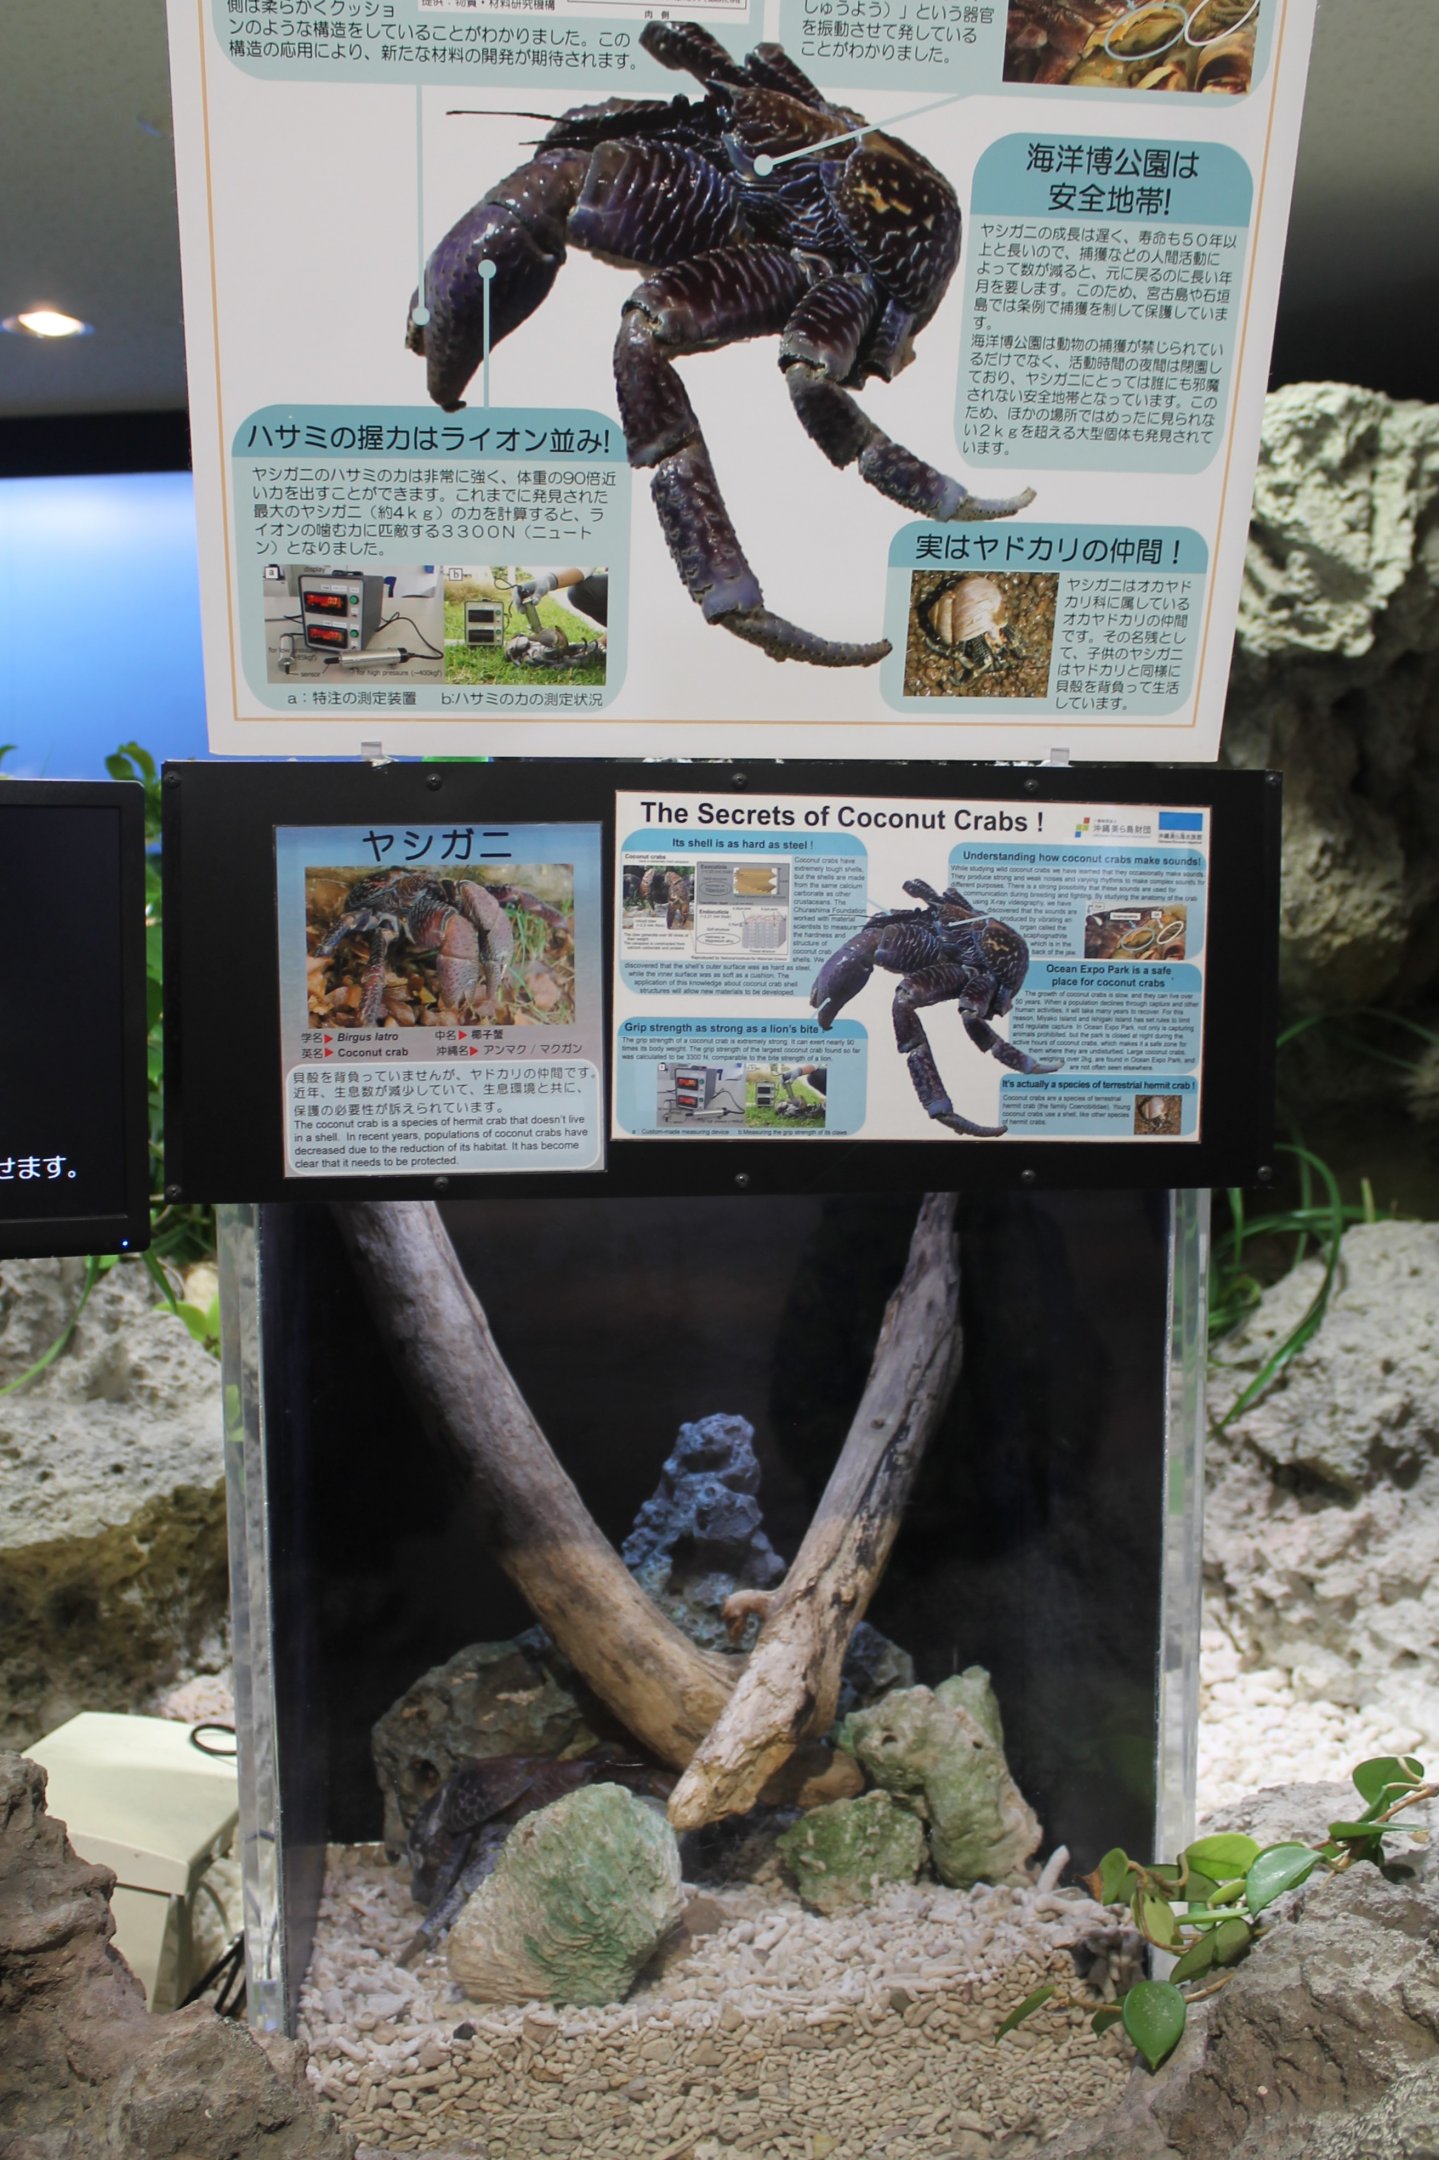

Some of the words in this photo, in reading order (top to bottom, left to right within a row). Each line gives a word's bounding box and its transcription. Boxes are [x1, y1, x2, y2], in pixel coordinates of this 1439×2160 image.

[802, 19, 977, 44] を振動させて発している
[801, 41, 950, 64] ことがわかりました。
[1026, 143, 1200, 179] 海洋博公園は
[973, 317, 992, 331] す。
[961, 442, 1011, 457] います。
[1066, 577, 1192, 593] ヤシガニはオカヤド
[1064, 595, 1191, 611] カリ科に属している
[1063, 612, 1188, 629] オカヤドカリの仲間
[1062, 629, 1186, 645] です。その名残とし
[1060, 646, 1184, 661] て、子供のヤシガニ
[1058, 663, 1181, 678] はヤドカリと同様に
[1056, 680, 1180, 695] 貝殻を背負って生活
[1055, 697, 1128, 711] しています。
[641, 802, 688, 823] The
[698, 803, 795, 826] Secrets
[804, 805, 830, 826] of
[837, 806, 946, 829] Coconut
[954, 809, 1028, 832] Crabs
[362, 827, 513, 862] ヤシガニ
[672, 838, 685, 848] Its
[688, 838, 713, 848] shell
[716, 838, 724, 848] is
[727, 840, 739, 848] as
[742, 839, 765, 849] hard
[768, 841, 780, 849] as
[783, 840, 808, 850] steel
[963, 851, 1036, 863] Understanding
[1039, 853, 1060, 862] how
[1062, 855, 1102, 864] coconut
[1104, 855, 1132, 864] crabs
[1134, 856, 1161, 865] make
[1162, 857, 1202, 866] sounds!
[1046, 963, 1077, 973] Ocean
[1080, 964, 1105, 975] Expo
[1108, 965, 1129, 974] Park
[1132, 966, 1140, 974] is
[1151, 966, 1172, 975] safe
[1052, 977, 1078, 987] place
[1081, 977, 1094, 986] for
[1097, 979, 1136, 987] coconut
[1139, 979, 1165, 987] crabs
[434, 1030, 456, 1041] 中名
[624, 1022, 647, 1033] Grip
[649, 1023, 692, 1034] strength
[695, 1025, 707, 1033] as
[710, 1024, 743, 1034] strong
[746, 1025, 758, 1033] as
[761, 1025, 767, 1033] a
[769, 1024, 797, 1033] lion's
[800, 1025, 819, 1034] bite
[301, 1032, 323, 1044] 学名
[336, 1032, 372, 1044] Birgus
[374, 1032, 399, 1041] latro
[301, 1048, 323, 1059] 英名
[337, 1047, 382, 1057] Coconut
[385, 1047, 409, 1057] crab
[541, 1042, 583, 1054] マクガン
[1002, 1080, 1015, 1088] It's
[1016, 1080, 1050, 1090] actually
[1059, 1081, 1090, 1090] species
[1092, 1080, 1102, 1089] of
[1102, 1080, 1142, 1090] terrestrial
[1143, 1081, 1170, 1090] hermit
[1172, 1081, 1191, 1090] crab
[294, 1120, 313, 1129] The
[315, 1120, 355, 1129] coconut
[357, 1119, 378, 1128] crab
[381, 1119, 389, 1128] is
[401, 1119, 438, 1129] species
[441, 1117, 450, 1126] of
[453, 1117, 484, 1126] hermit
[486, 1116, 507, 1125] crab
[510, 1116, 529, 1125] that
[531, 1115, 566, 1125] doesn't
[568, 1115, 585, 1124] live
[294, 1133, 304, 1142] in
[346, 1132, 356, 1141] In
[358, 1132, 389, 1141] recent
[424, 1130, 480, 1141] populations
[482, 1129, 492, 1138] of
[495, 1129, 533, 1138] coconut
[535, 1128, 562, 1137] crabs
[565, 1127, 588, 1136] have
[294, 1145, 346, 1155] decreased
[348, 1145, 367, 1154] due
[370, 1145, 379, 1154] to
[382, 1144, 397, 1153] the
[400, 1143, 444, 1153] reduction
[447, 1143, 457, 1152] of
[460, 1142, 471, 1151] its
[512, 1141, 519, 1150] It
[521, 1141, 538, 1150] has
[541, 1140, 579, 1150] become
[0, 1155, 77, 1179] せます。
[294, 1159, 319, 1168] clear
[322, 1158, 340, 1168] that
[343, 1158, 349, 1167] it
[351, 1158, 381, 1167] needs
[384, 1157, 393, 1166] to
[396, 1157, 408, 1166] be
